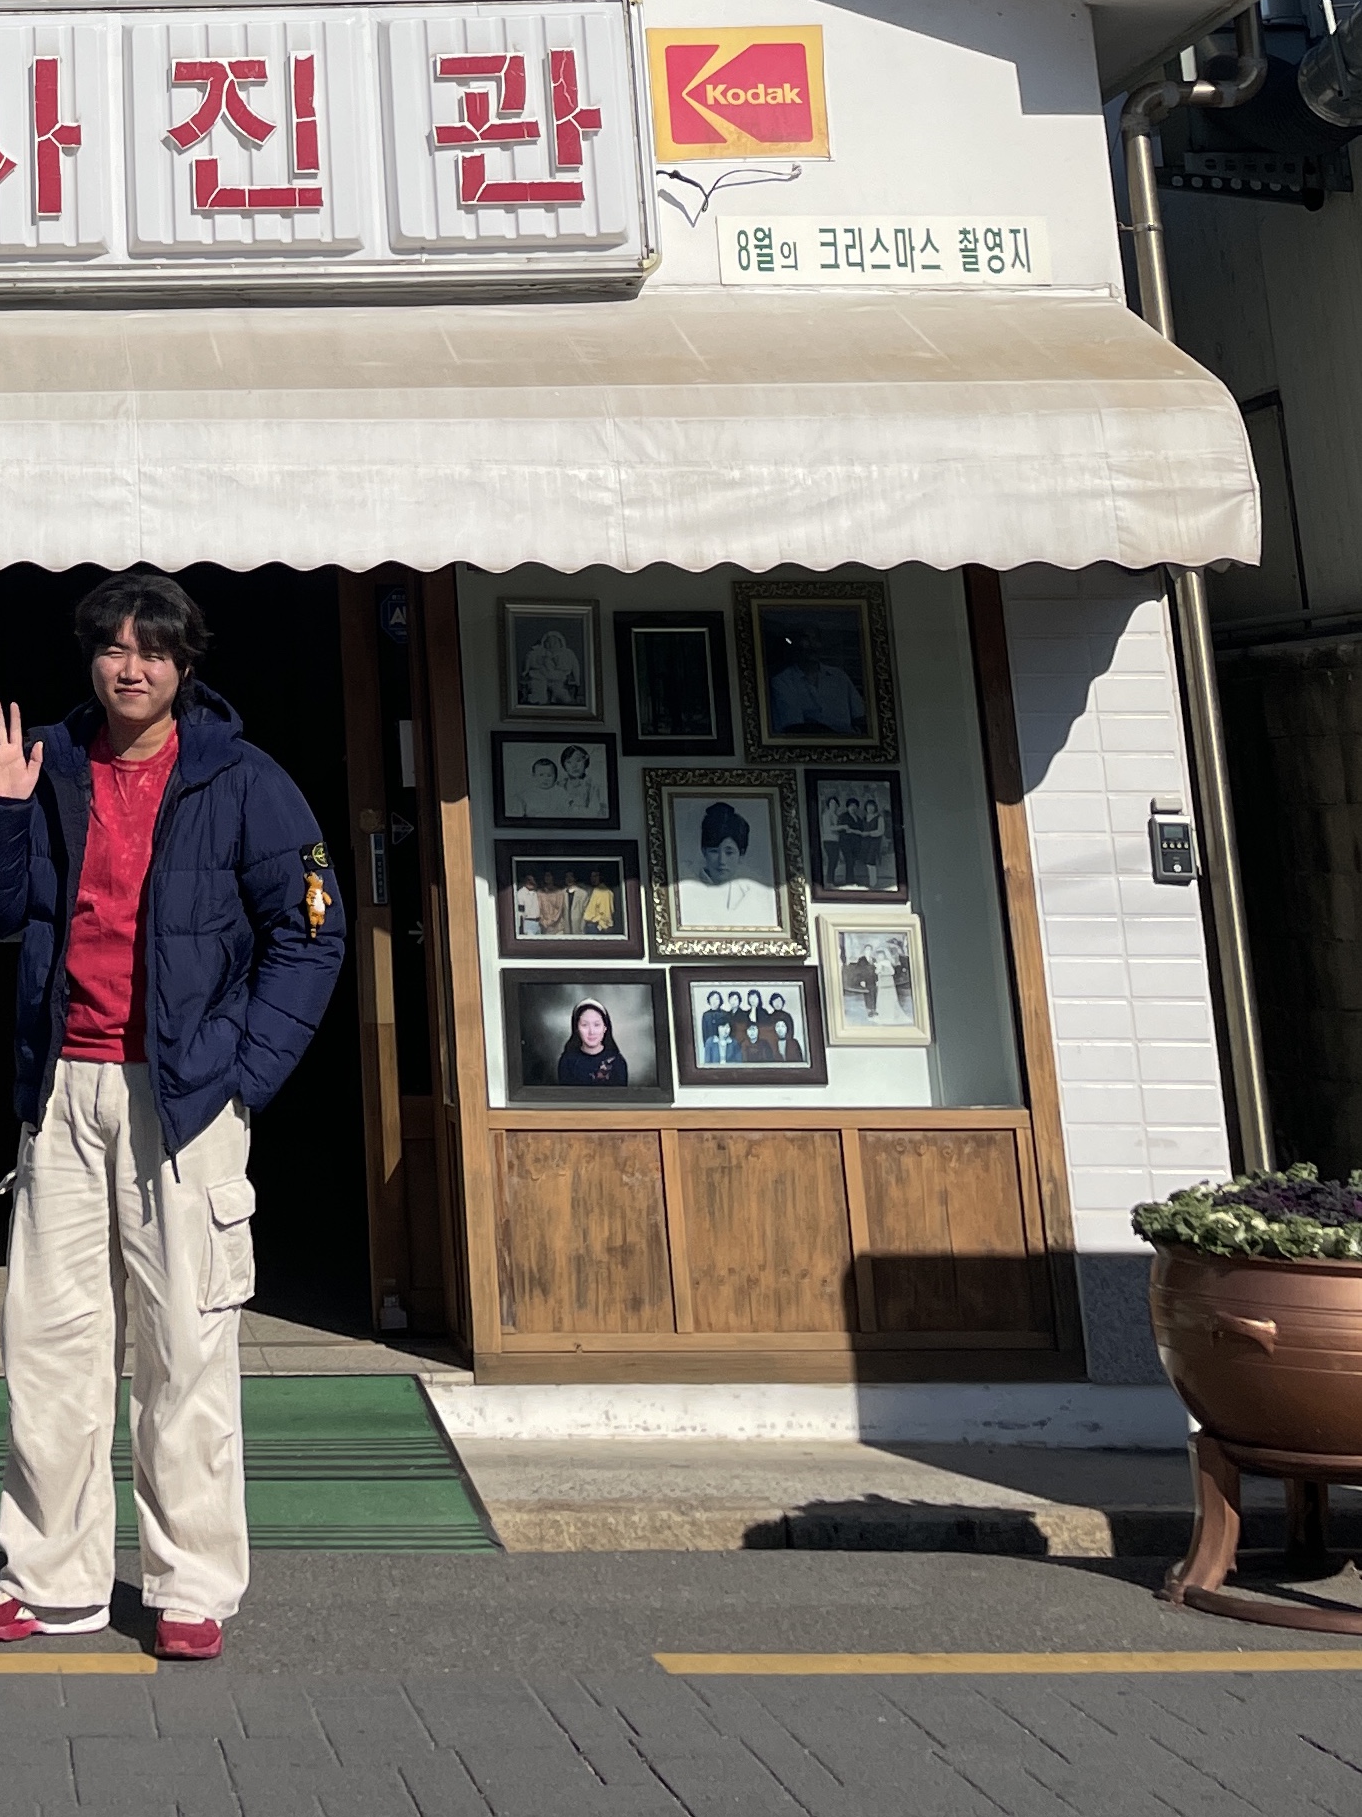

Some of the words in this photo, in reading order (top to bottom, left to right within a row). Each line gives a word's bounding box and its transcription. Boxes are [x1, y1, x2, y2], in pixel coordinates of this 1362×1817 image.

[705, 83, 803, 106] Kodak
[737, 226, 799, 272] 8월의
[818, 226, 945, 272] 크리스마스
[958, 226, 1032, 274] 촬영지
